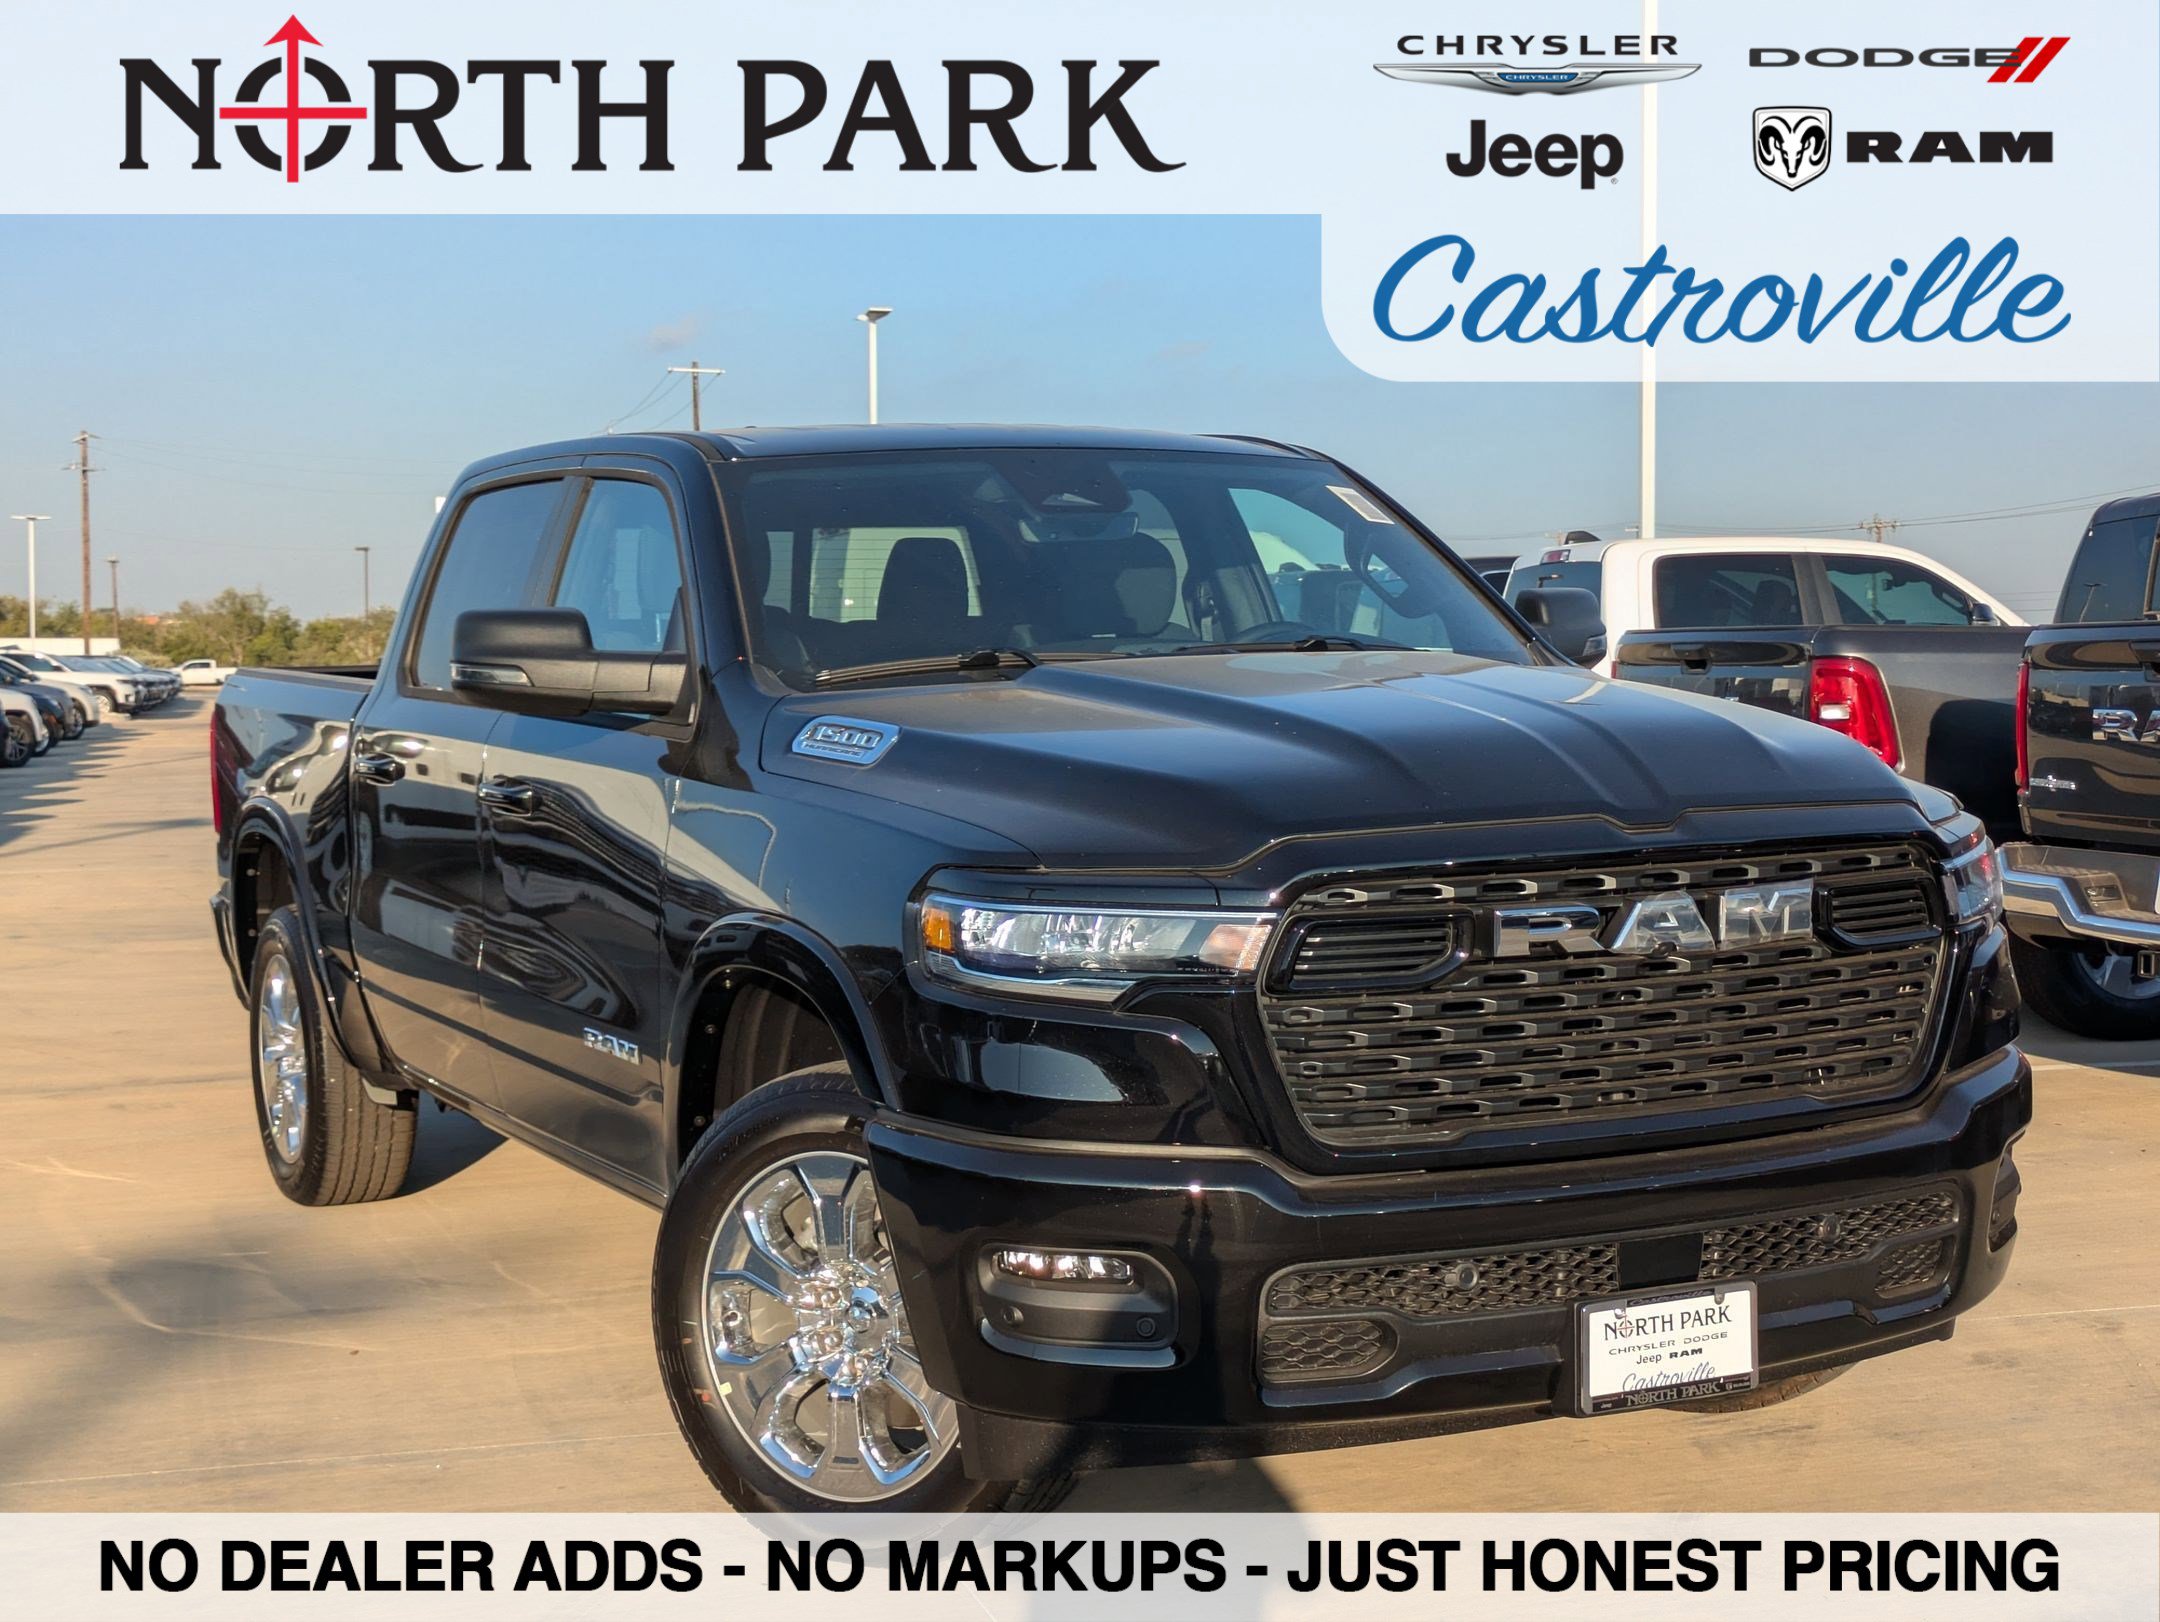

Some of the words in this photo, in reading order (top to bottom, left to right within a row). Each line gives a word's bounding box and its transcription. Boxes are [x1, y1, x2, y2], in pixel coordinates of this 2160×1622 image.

[808, 725, 880, 749] 1500
[1494, 884, 1814, 957] RAM
[584, 1027, 639, 1065] RAM
[1604, 1313, 1674, 1341] NORTH
[1681, 1305, 1732, 1330] PARK
[1609, 1339, 1675, 1356] CHRYSLER
[1684, 1331, 1728, 1345] DODGE
[1636, 1353, 1662, 1365] Jeep
[1669, 1347, 1703, 1360] RAM
[1622, 1361, 1716, 1392] Castroville
[1625, 1387, 1678, 1407] NORTH
[1682, 1381, 1721, 1398] PARK
